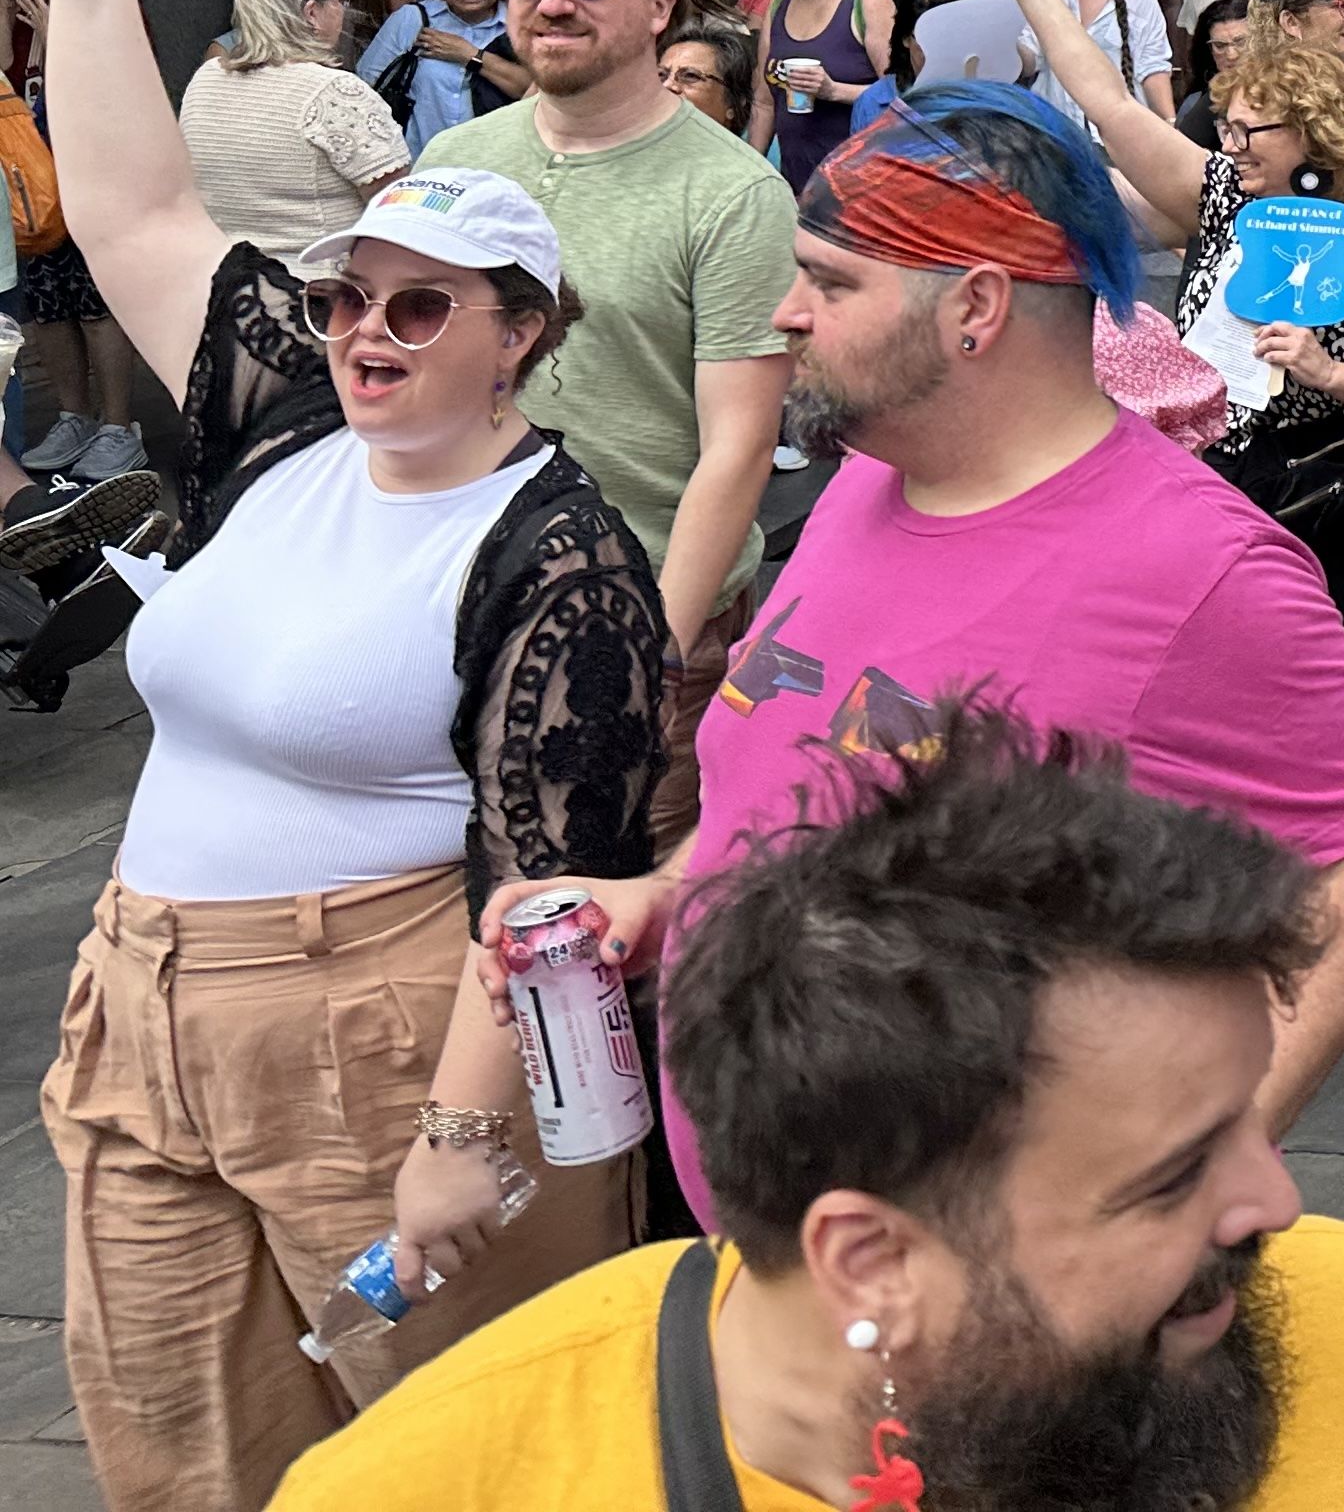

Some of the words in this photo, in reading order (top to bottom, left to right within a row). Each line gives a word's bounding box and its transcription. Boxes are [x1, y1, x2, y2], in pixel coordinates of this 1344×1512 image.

[1266, 205, 1290, 216] I'm
[1291, 208, 1300, 217] a
[1302, 207, 1327, 218] FAN
[1328, 210, 1342, 220] of
[1246, 218, 1297, 232] Richard
[549, 943, 568, 959] 24
[518, 1009, 536, 1051] BERRY
[528, 1053, 543, 1086] WILD
